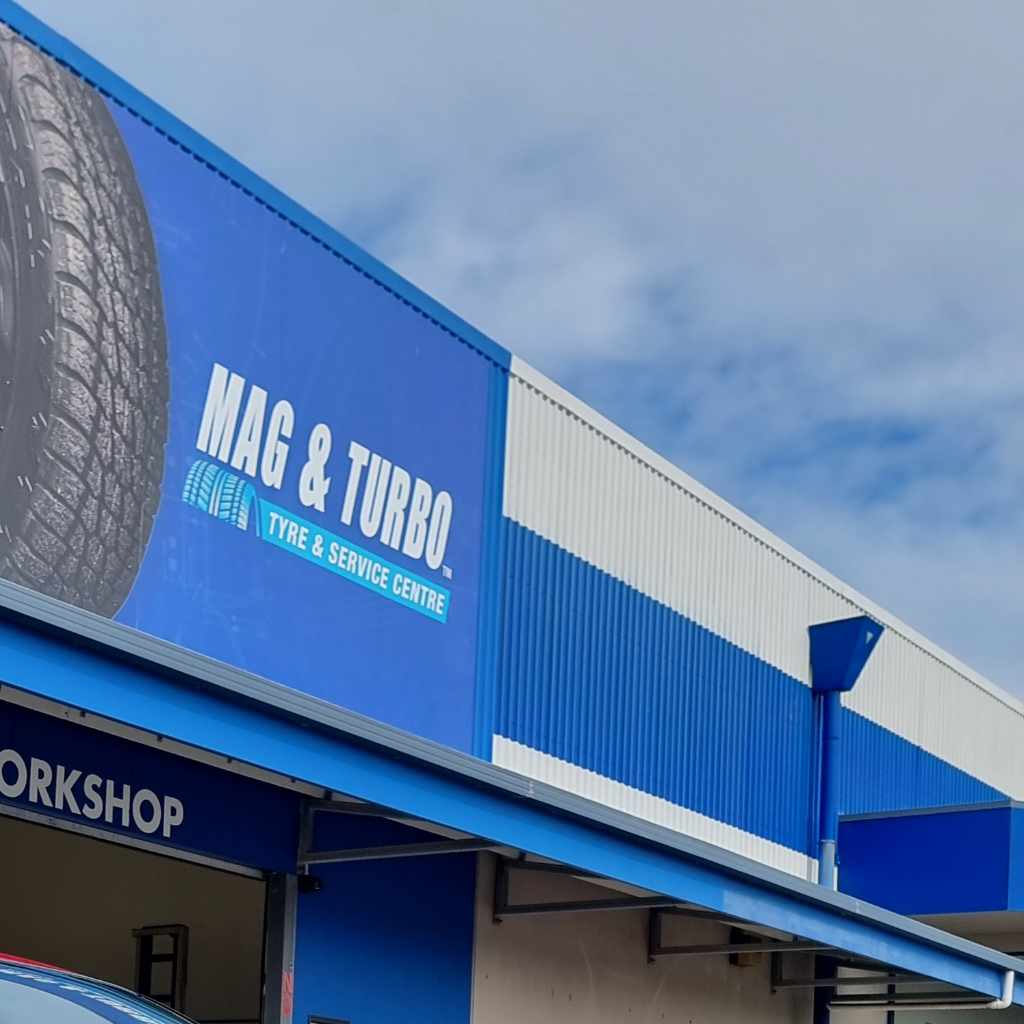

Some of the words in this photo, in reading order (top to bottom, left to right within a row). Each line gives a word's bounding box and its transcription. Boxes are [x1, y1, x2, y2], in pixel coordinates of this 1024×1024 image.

[195, 362, 295, 490] MAG
[298, 423, 333, 513] &
[340, 440, 453, 571] TURBO
[267, 511, 309, 551] TYRE
[311, 534, 325, 558] &
[327, 542, 390, 590] SERVICE
[392, 573, 446, 615] CENTRE
